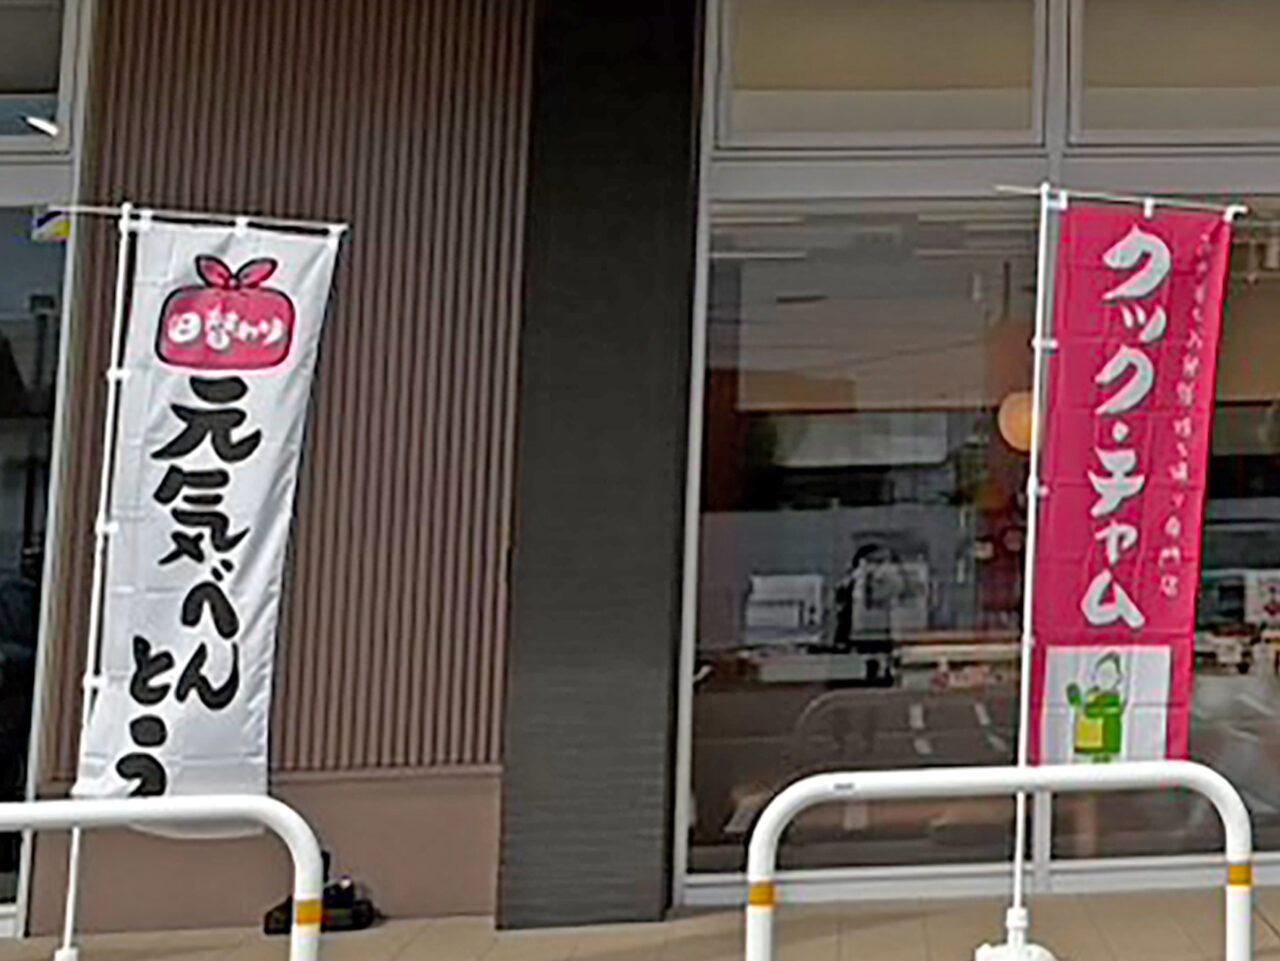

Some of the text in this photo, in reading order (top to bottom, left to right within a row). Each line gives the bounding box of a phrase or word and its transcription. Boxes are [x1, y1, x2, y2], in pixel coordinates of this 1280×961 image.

[1080, 224, 1172, 629] クック・チャム
